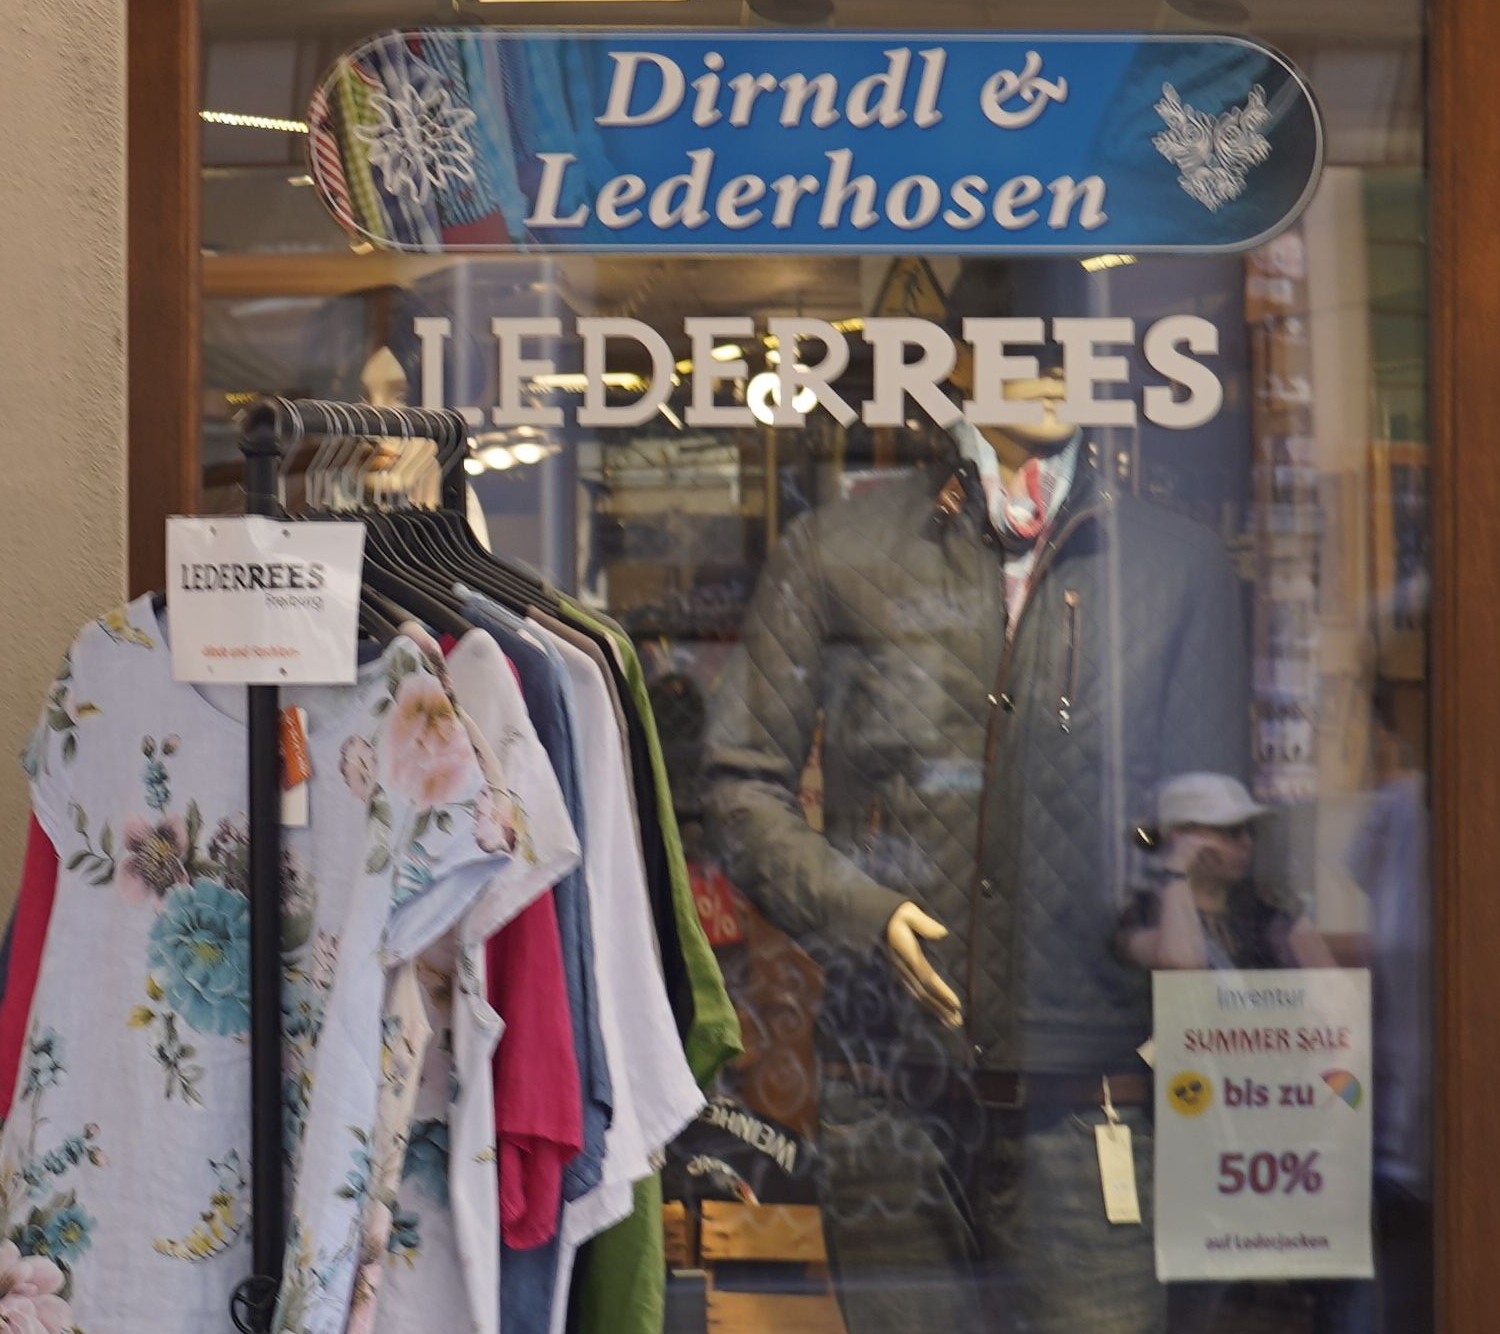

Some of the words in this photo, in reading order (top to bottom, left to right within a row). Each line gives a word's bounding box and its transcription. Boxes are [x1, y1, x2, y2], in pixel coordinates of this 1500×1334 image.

[594, 46, 947, 128] Dirndl
[979, 50, 1068, 129] &
[524, 147, 1108, 230] Lederhosen
[414, 313, 1223, 430] LEDERREES
[180, 561, 328, 592] LEDERREES
[1217, 987, 1307, 1009] Inventur
[1184, 1027, 1291, 1053] SUMMER
[1297, 1027, 1351, 1051] SALE
[1223, 1076, 1268, 1108] bis
[1279, 1084, 1315, 1108] zu
[1217, 1151, 1324, 1194] 50%
